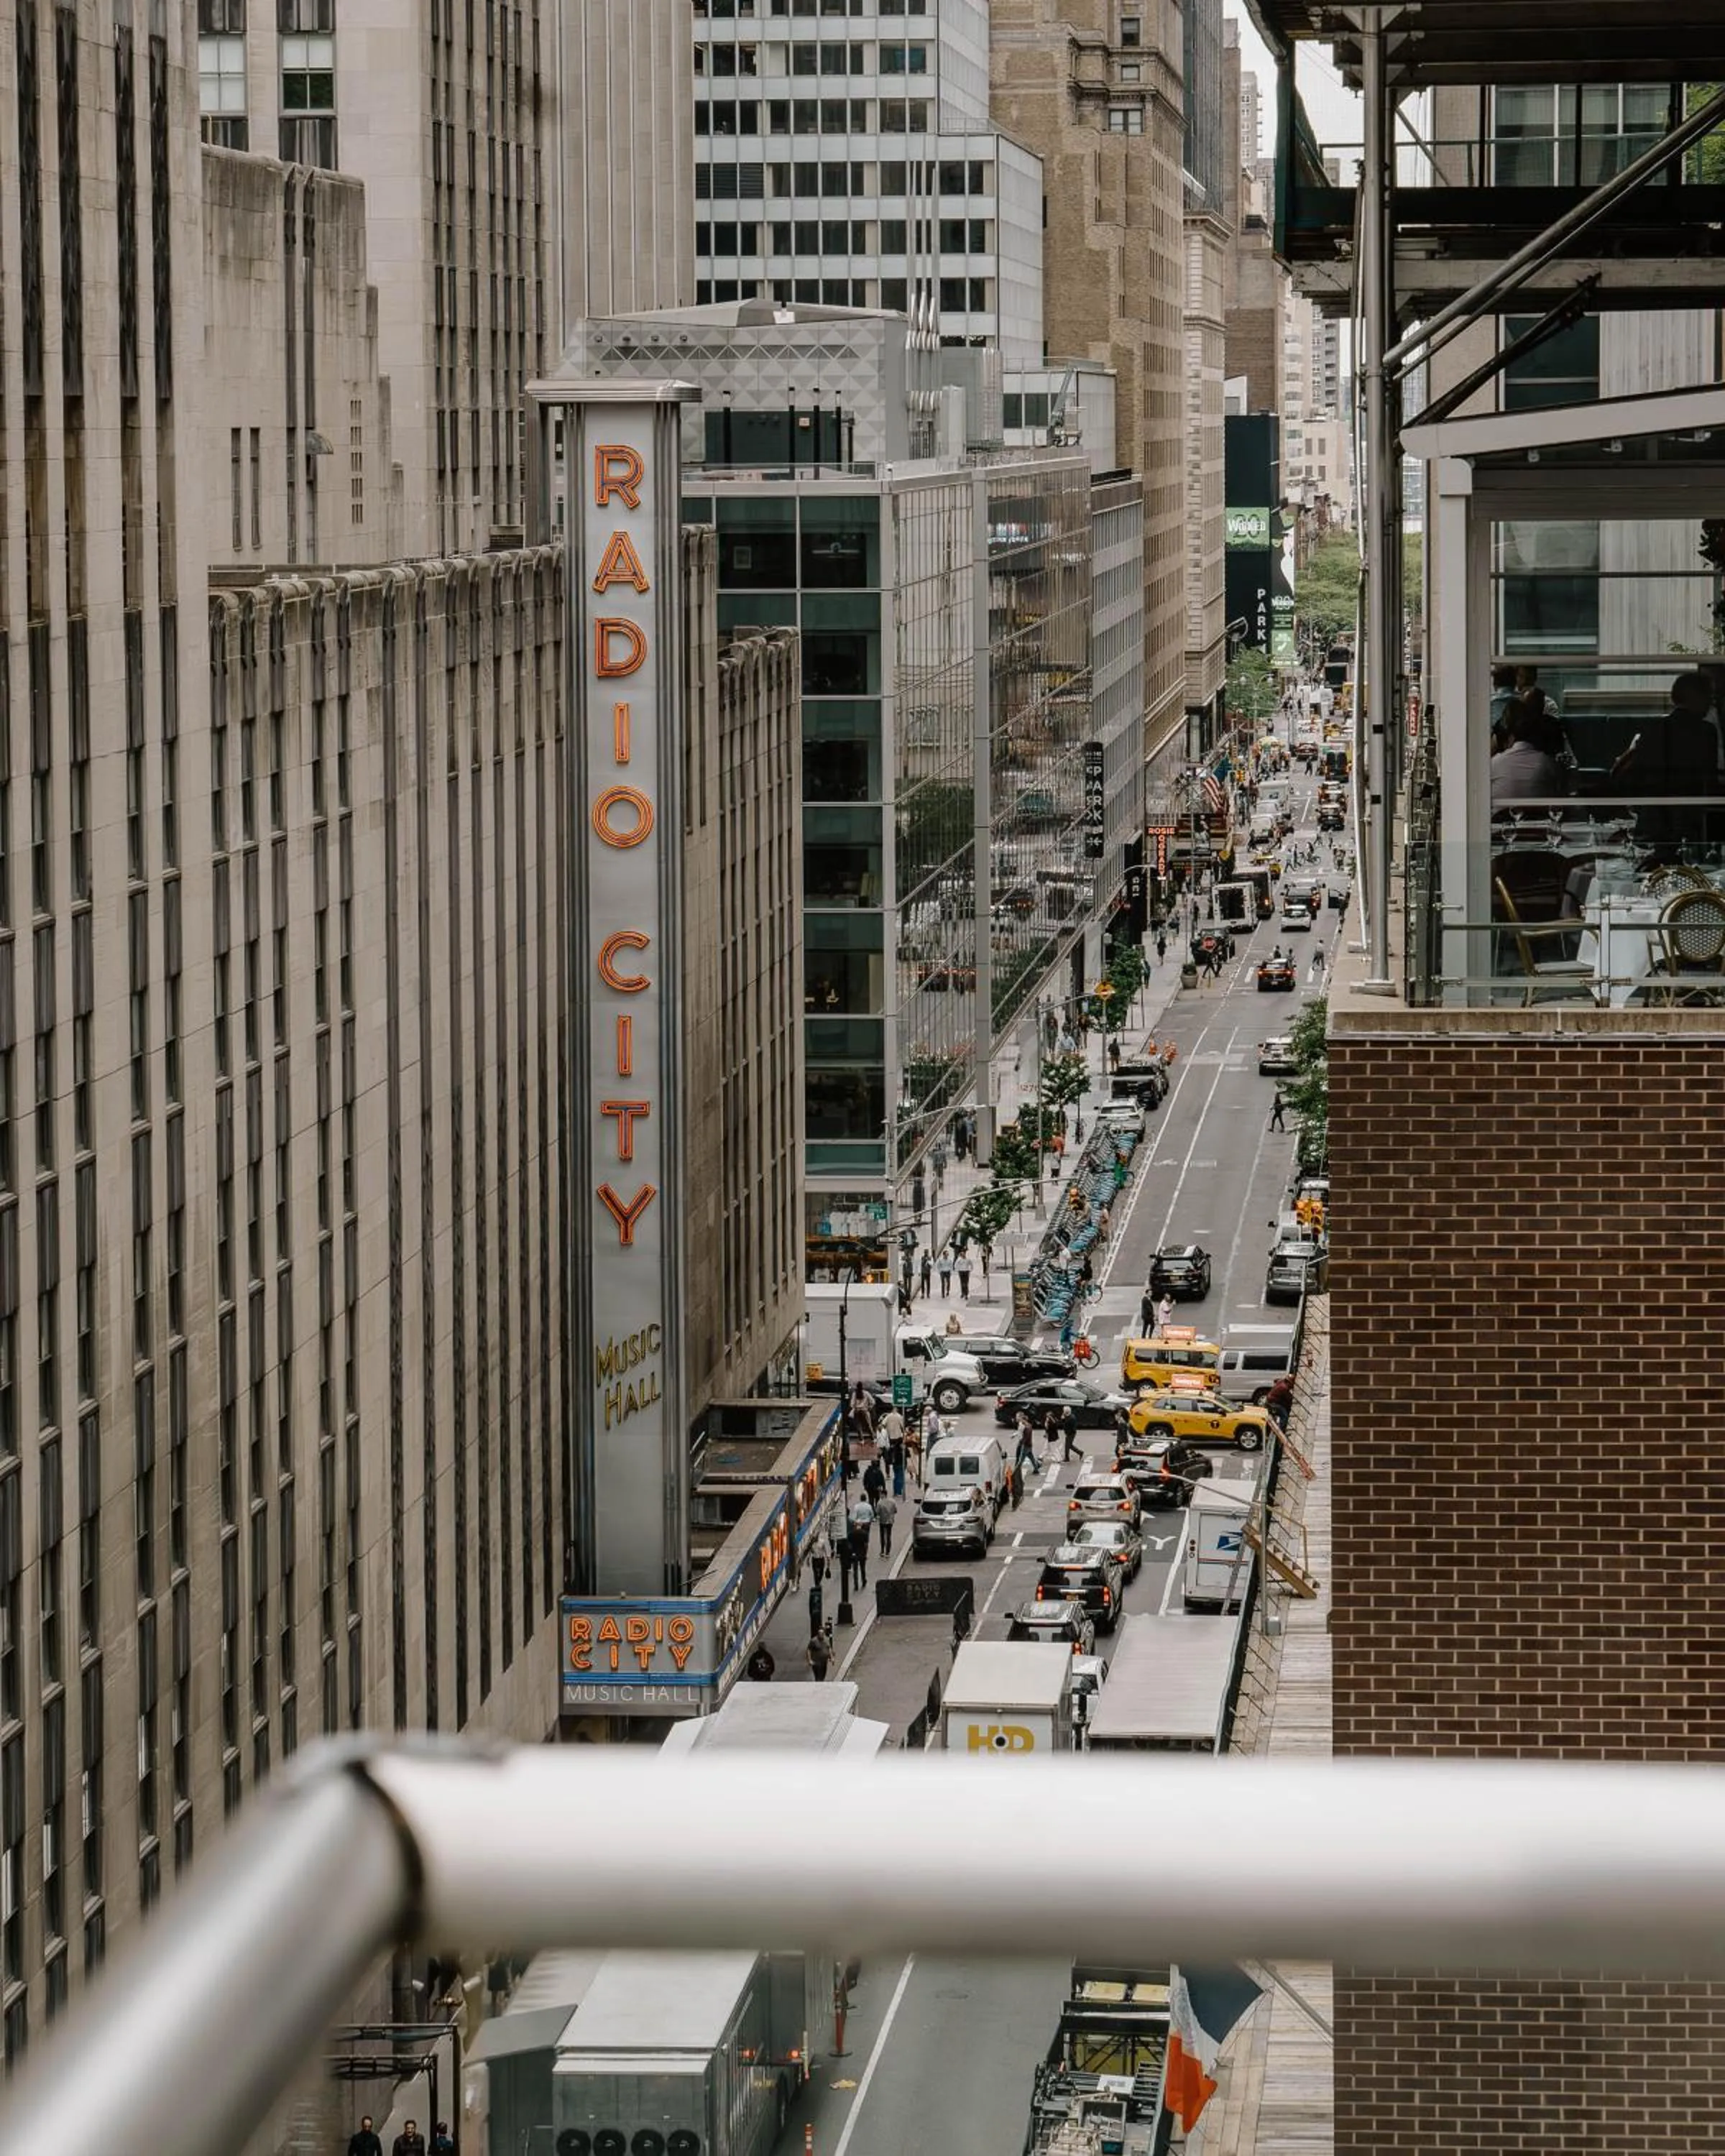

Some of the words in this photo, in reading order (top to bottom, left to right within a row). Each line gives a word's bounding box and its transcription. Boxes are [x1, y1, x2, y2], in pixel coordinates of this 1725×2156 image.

[1257, 588, 1266, 640] PARK
[593, 444, 654, 849] RADIO
[1093, 765, 1103, 821] PARK
[597, 931, 657, 1246] CITY
[596, 1323, 662, 1388] MUSIC
[605, 1370, 662, 1431] HALL
[570, 1615, 693, 1643] RADIO
[570, 1644, 693, 1671] CITY
[566, 1685, 633, 1701] MUSIC
[643, 1685, 699, 1701] HALL
